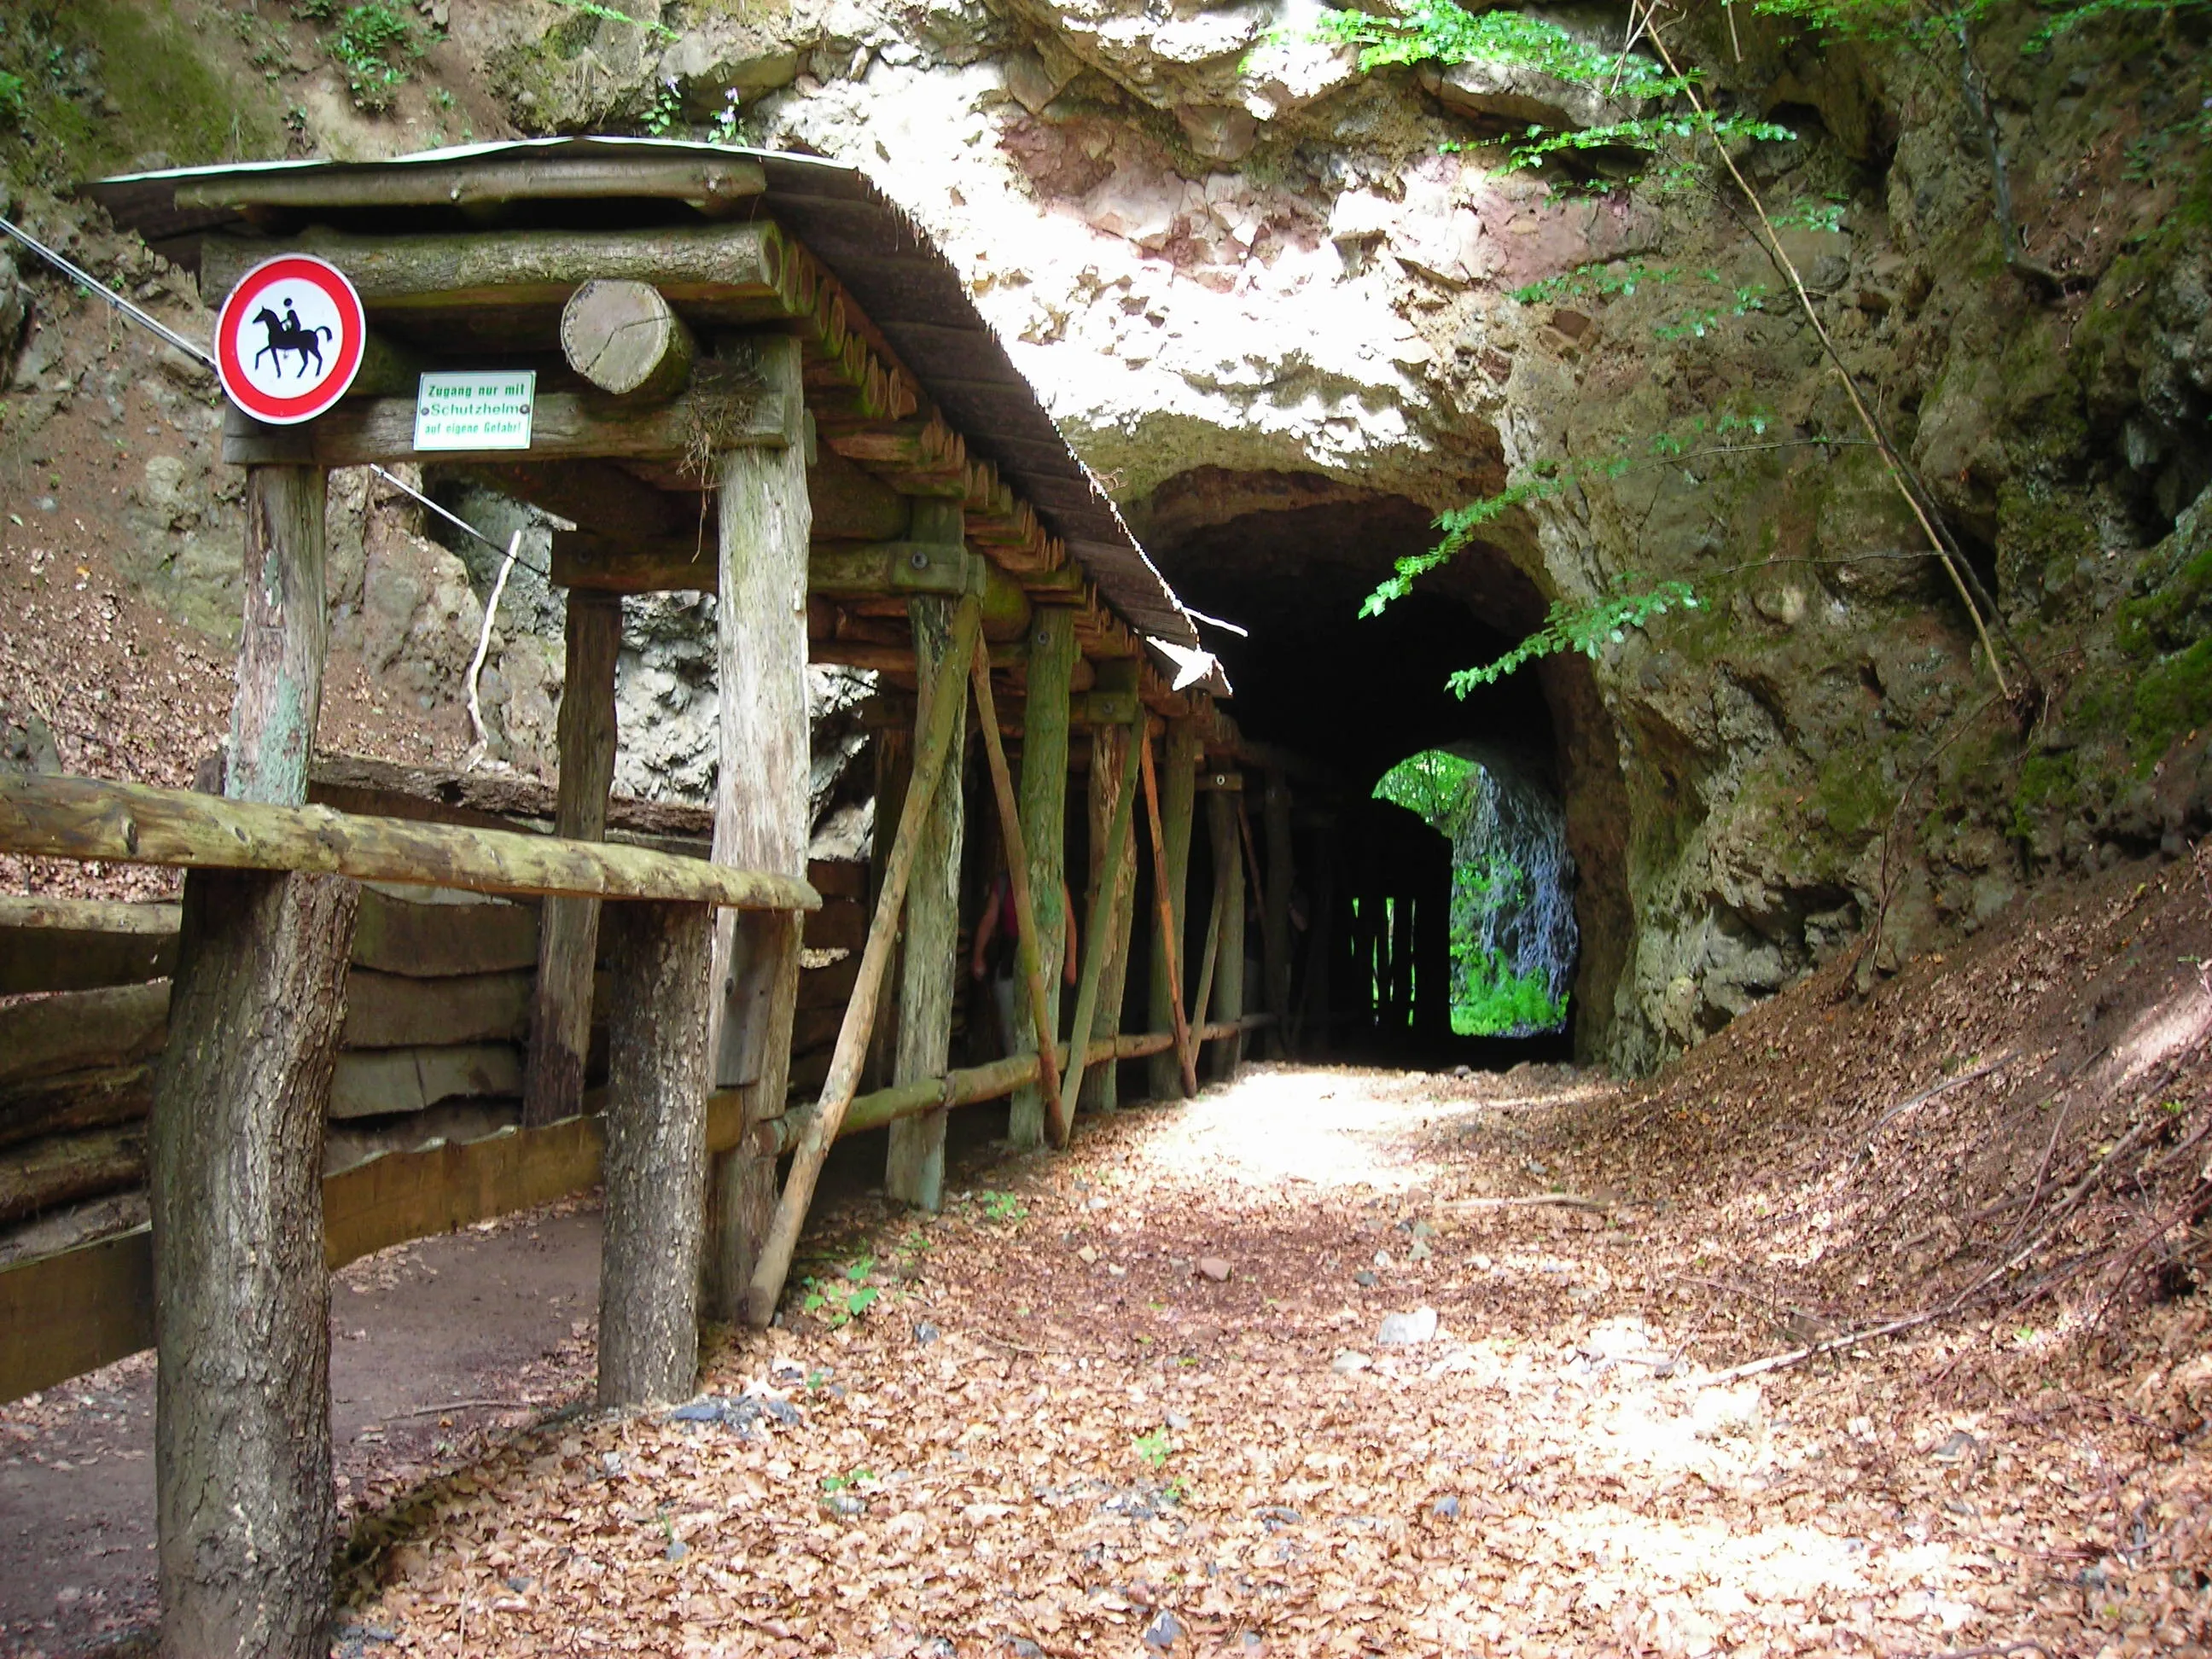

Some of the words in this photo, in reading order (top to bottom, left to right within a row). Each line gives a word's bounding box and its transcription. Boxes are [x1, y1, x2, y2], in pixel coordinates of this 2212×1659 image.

[428, 385, 472, 399] Zugang
[478, 385, 498, 396] nur
[504, 383, 525, 396] mit
[430, 403, 519, 416] Schutzhelm
[425, 422, 441, 434] auf
[445, 423, 479, 435] eigene
[484, 422, 521, 434] Gefahr!
